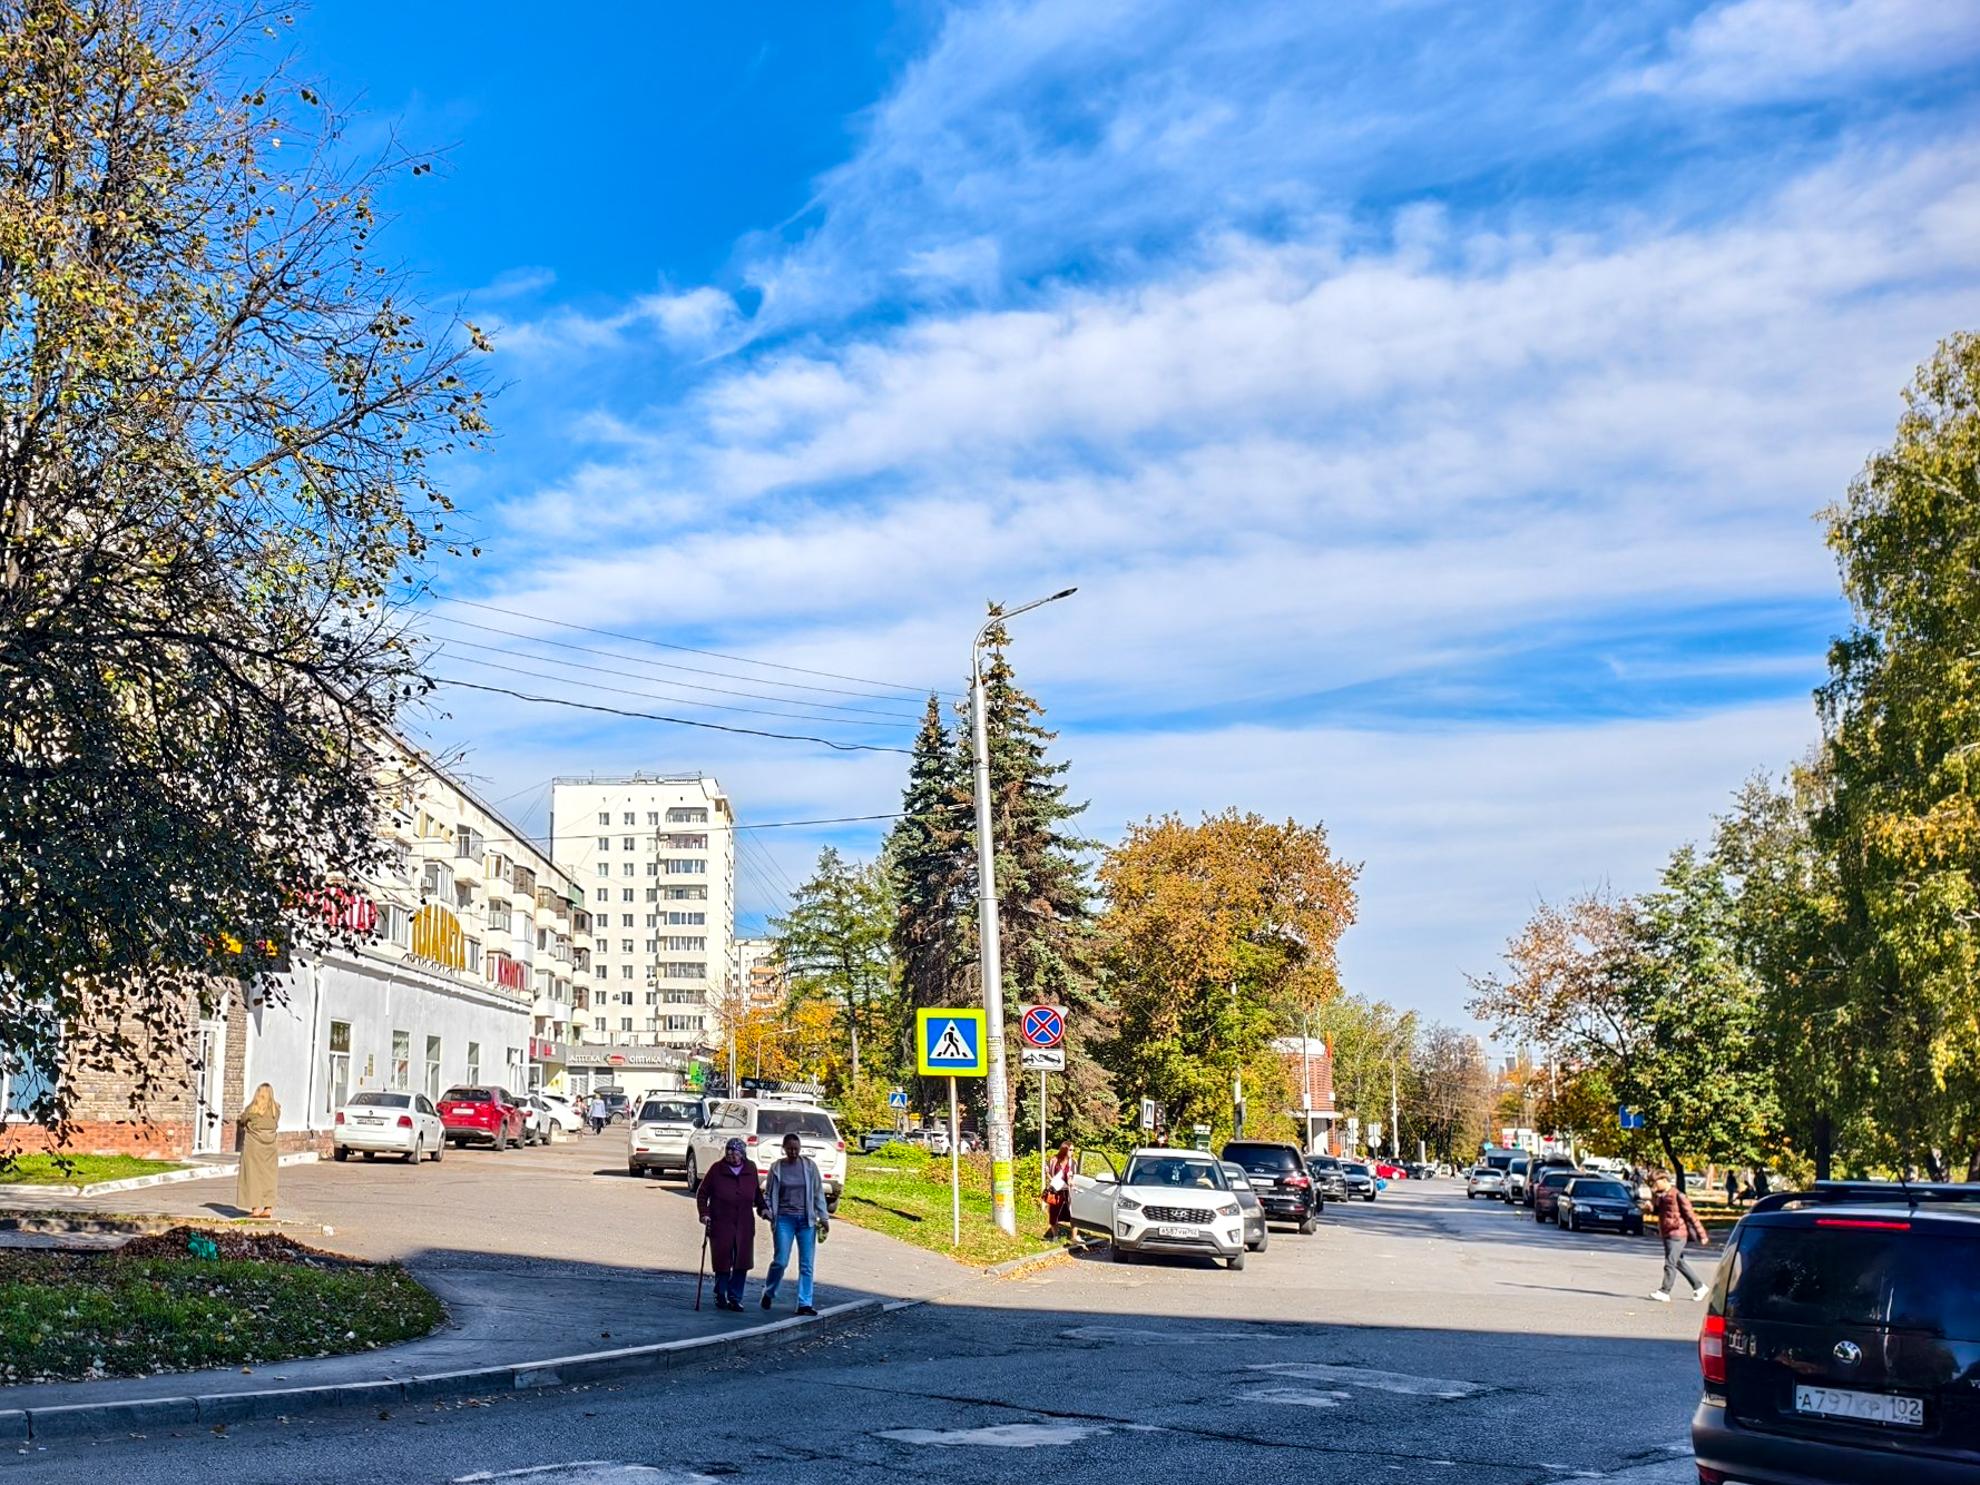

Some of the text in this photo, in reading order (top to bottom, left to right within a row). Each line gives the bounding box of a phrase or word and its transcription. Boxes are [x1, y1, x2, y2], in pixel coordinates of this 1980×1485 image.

[412, 903, 466, 972] ПЛАНЕТА
[498, 954, 526, 992] КНИГИ
[569, 1054, 600, 1064] АПТЕКА
[628, 1053, 662, 1065] ОПТИКА
